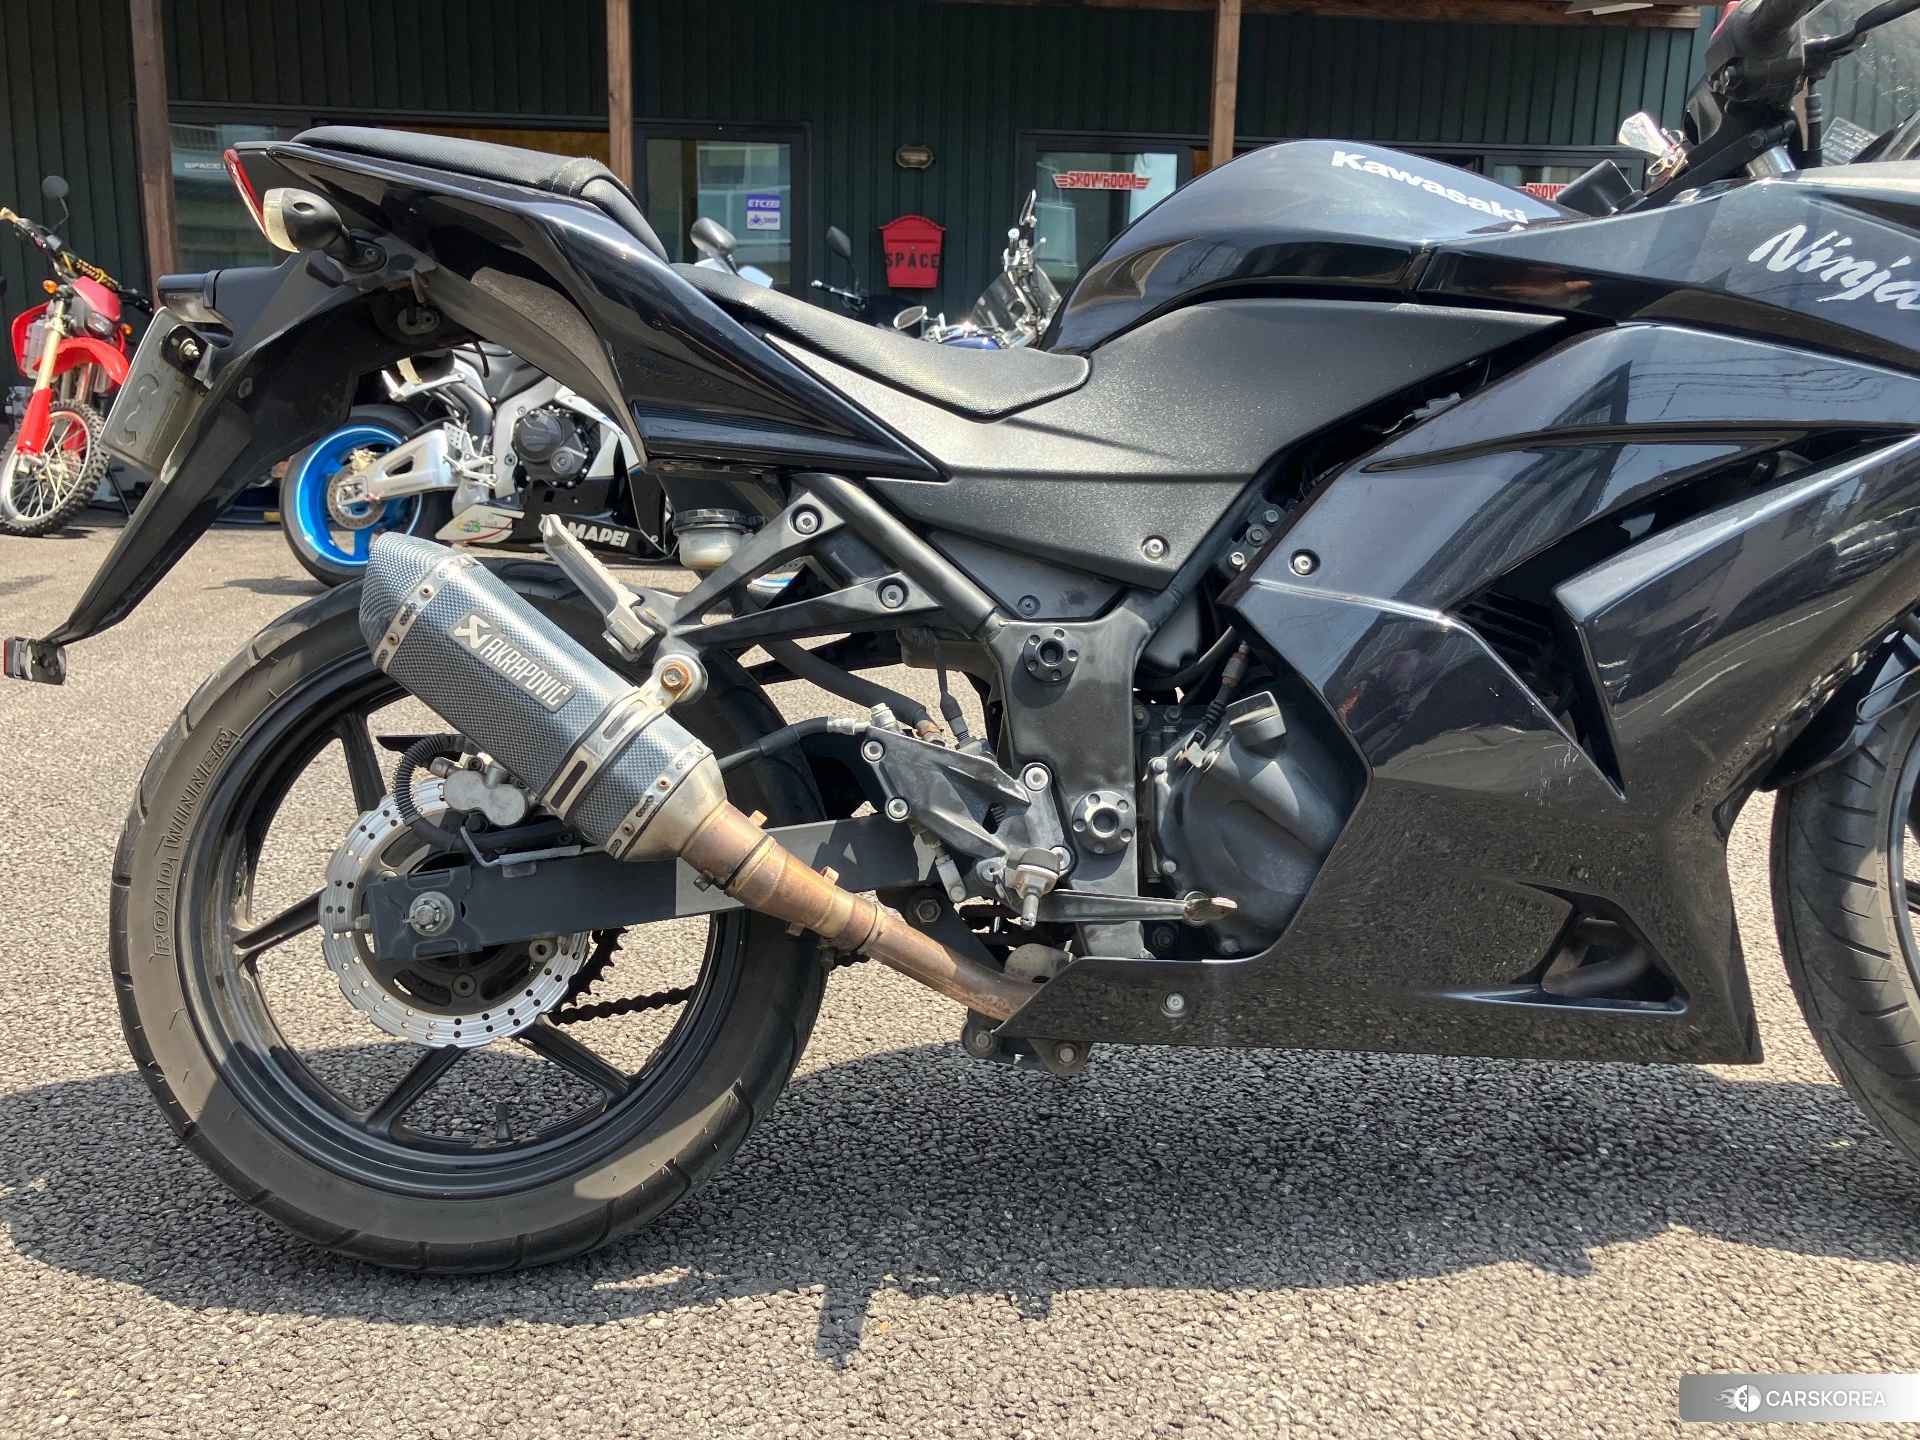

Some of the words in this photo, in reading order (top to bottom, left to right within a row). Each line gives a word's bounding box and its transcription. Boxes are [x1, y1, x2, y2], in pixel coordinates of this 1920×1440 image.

[1331, 150, 1529, 224] Kawasaki
[1527, 184, 1567, 199] SHOW
[885, 252, 941, 269] SPACE
[1747, 223, 1920, 310] Ninja
[567, 521, 630, 548] MAPEI
[153, 859, 175, 957] ROAD
[164, 728, 235, 850] WINNER
